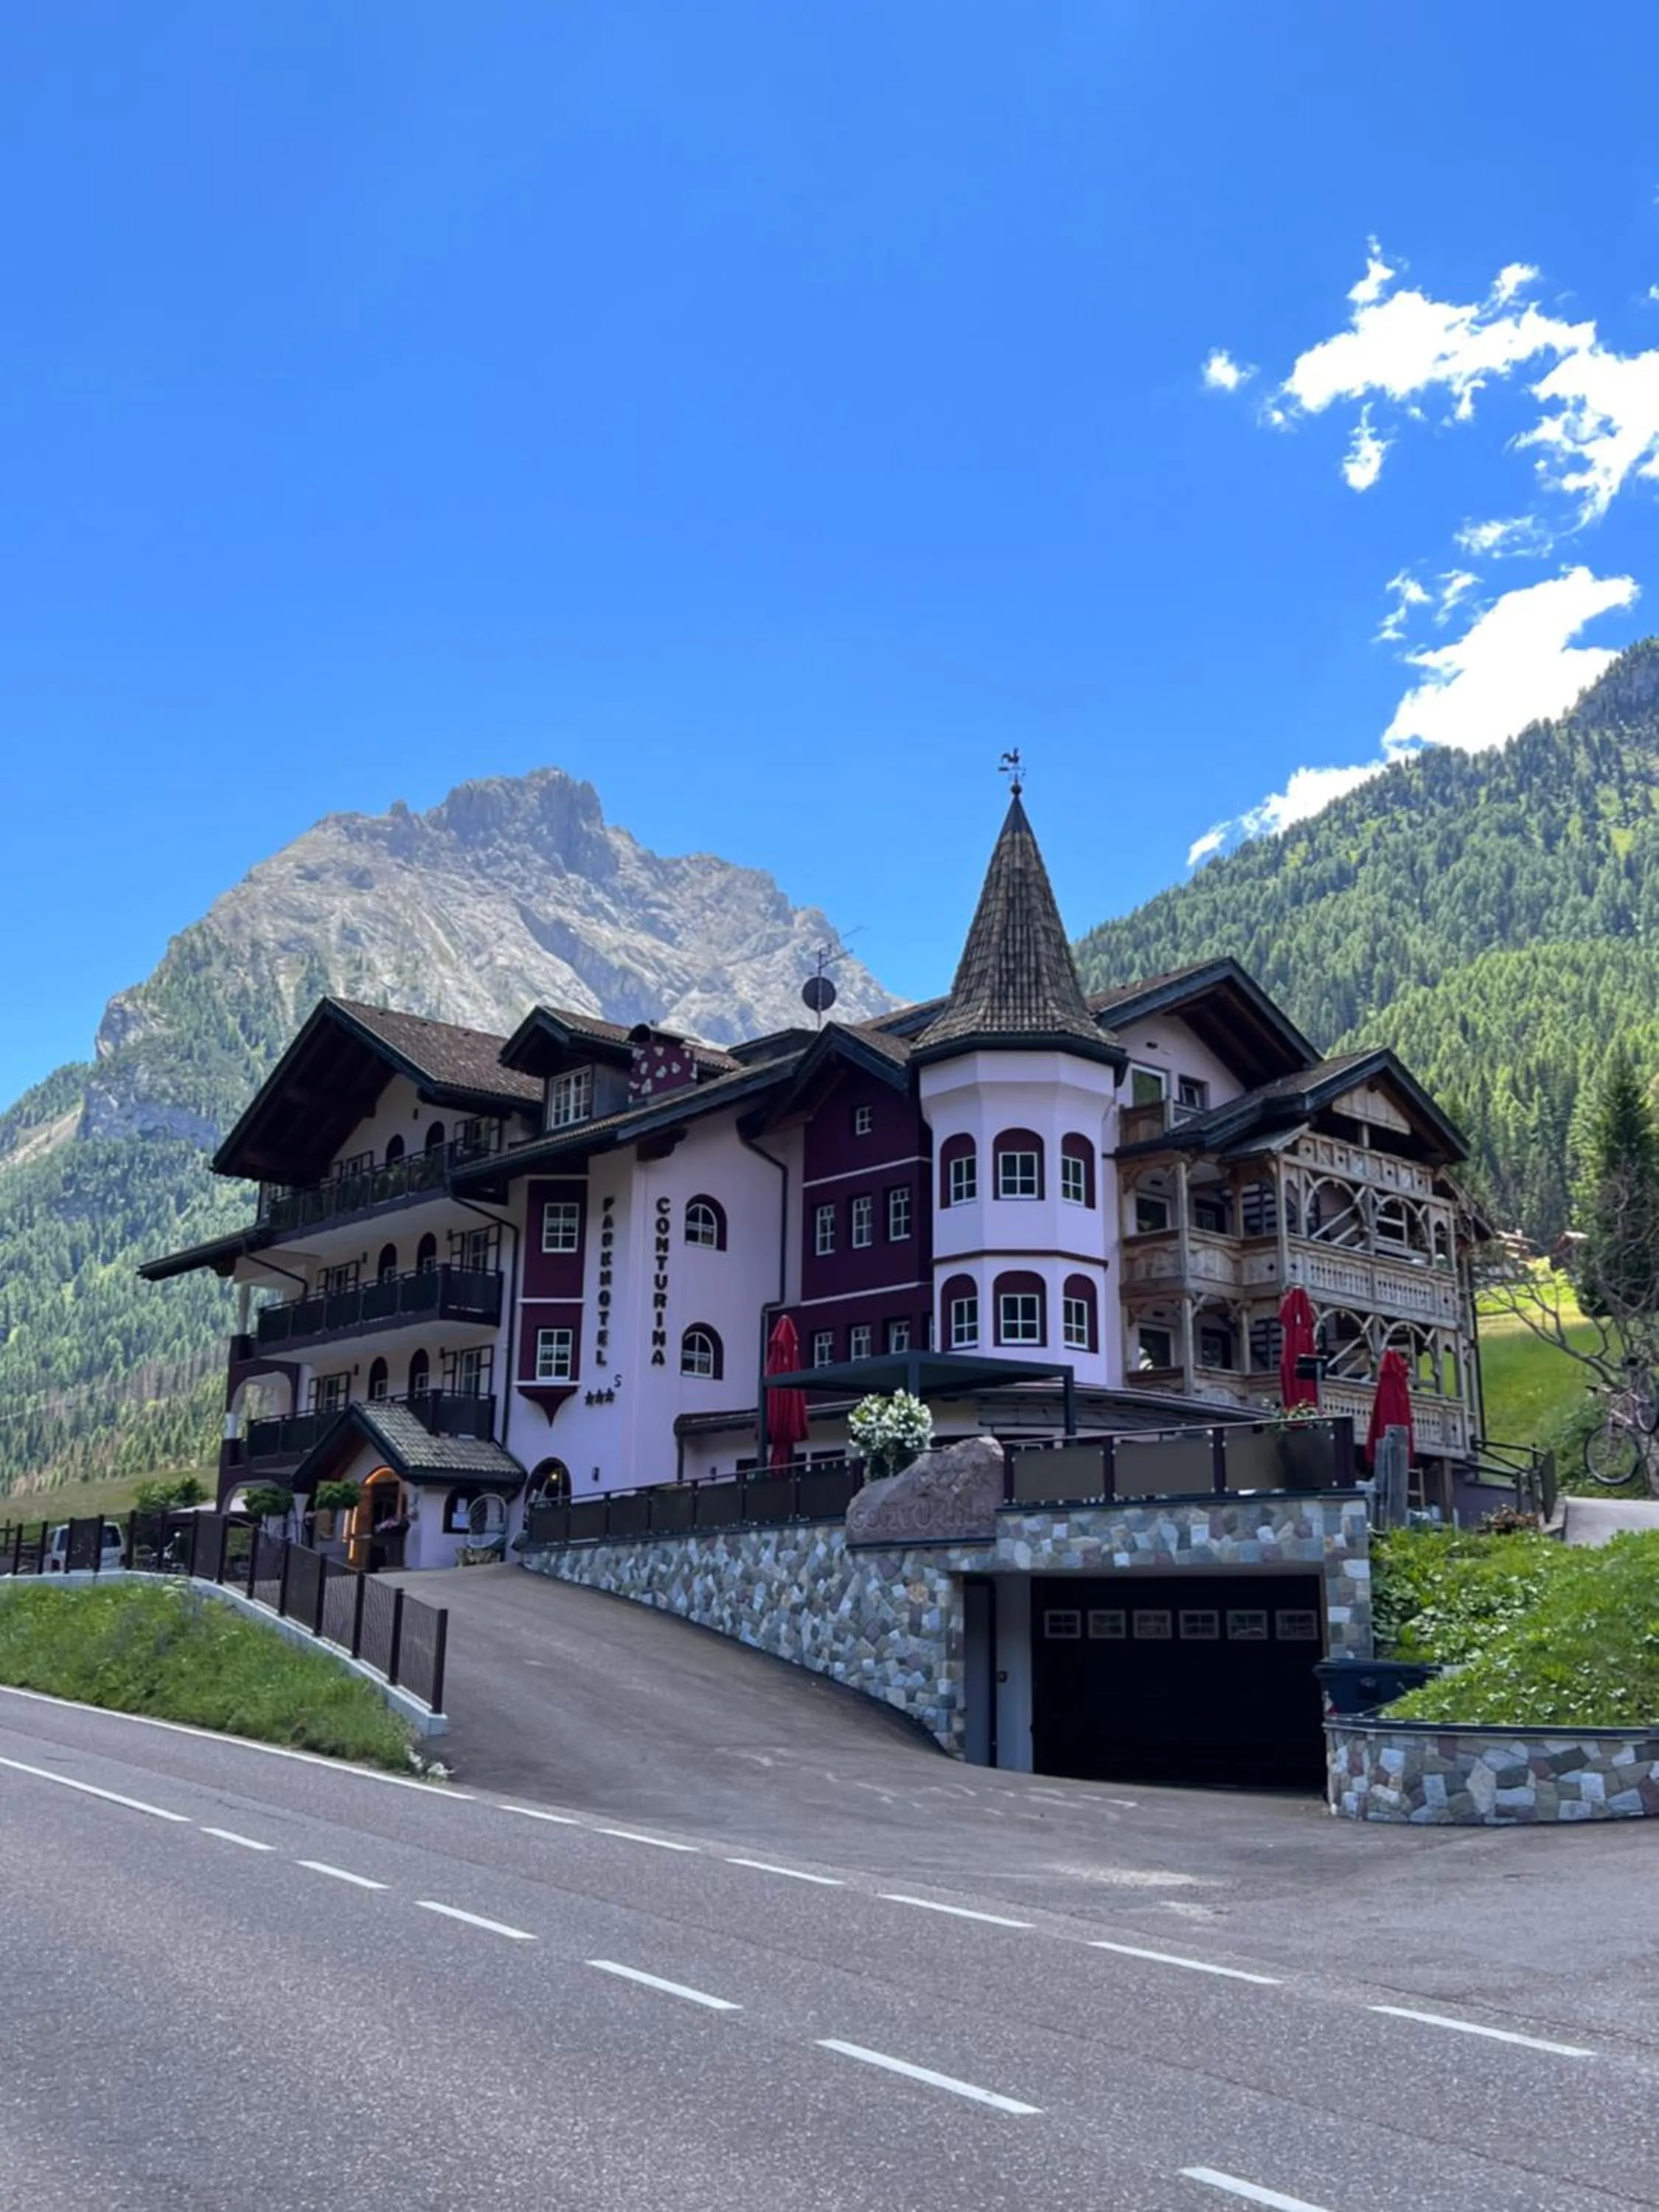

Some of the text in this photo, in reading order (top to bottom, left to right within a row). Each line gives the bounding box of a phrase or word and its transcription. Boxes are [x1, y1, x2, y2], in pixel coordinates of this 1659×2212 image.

[596, 1196, 614, 1366] PARKHOTEL
[652, 1197, 670, 1366] CONTURINA
[613, 1374, 622, 1388] S
